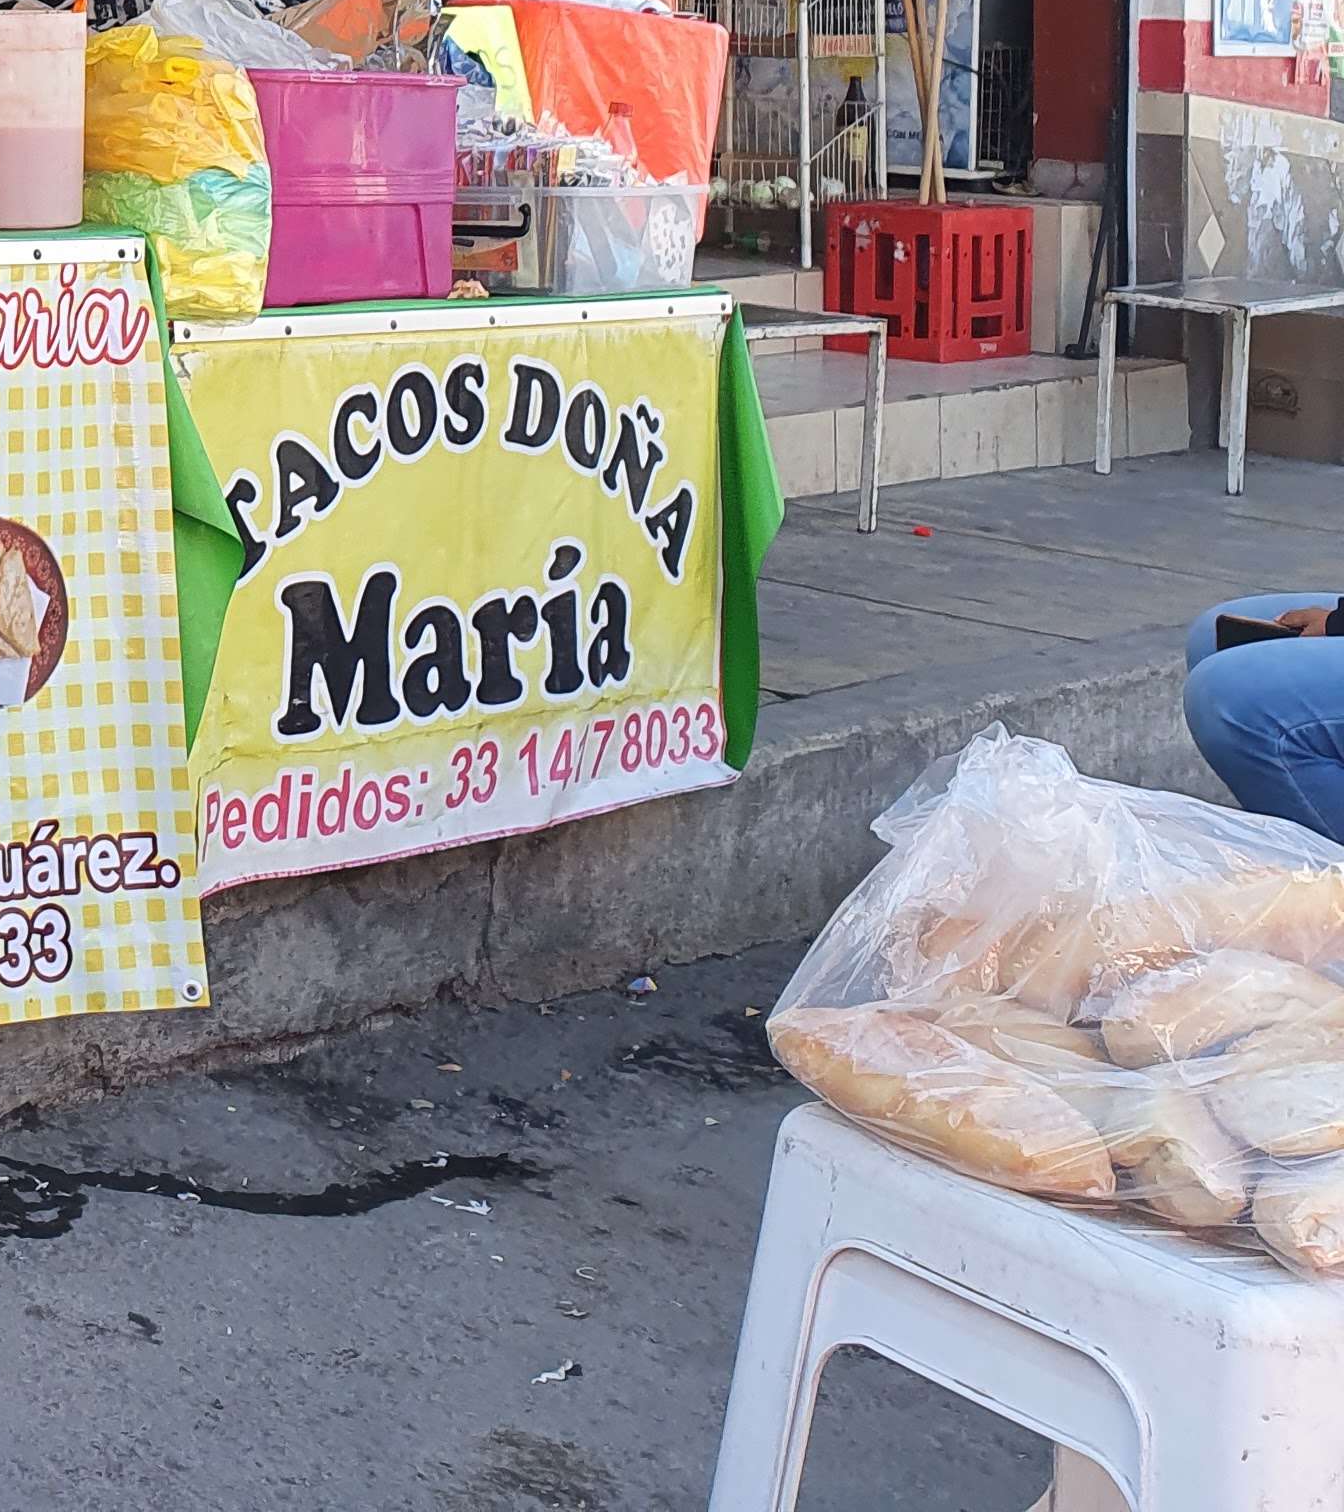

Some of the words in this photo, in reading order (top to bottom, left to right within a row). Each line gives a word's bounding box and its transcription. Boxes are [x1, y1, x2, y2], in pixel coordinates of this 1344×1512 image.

[224, 363, 485, 581] TACOS
[504, 361, 695, 579] DOÑA
[277, 544, 632, 737] María
[202, 769, 429, 863] Pedidos:
[445, 740, 499, 809] 33
